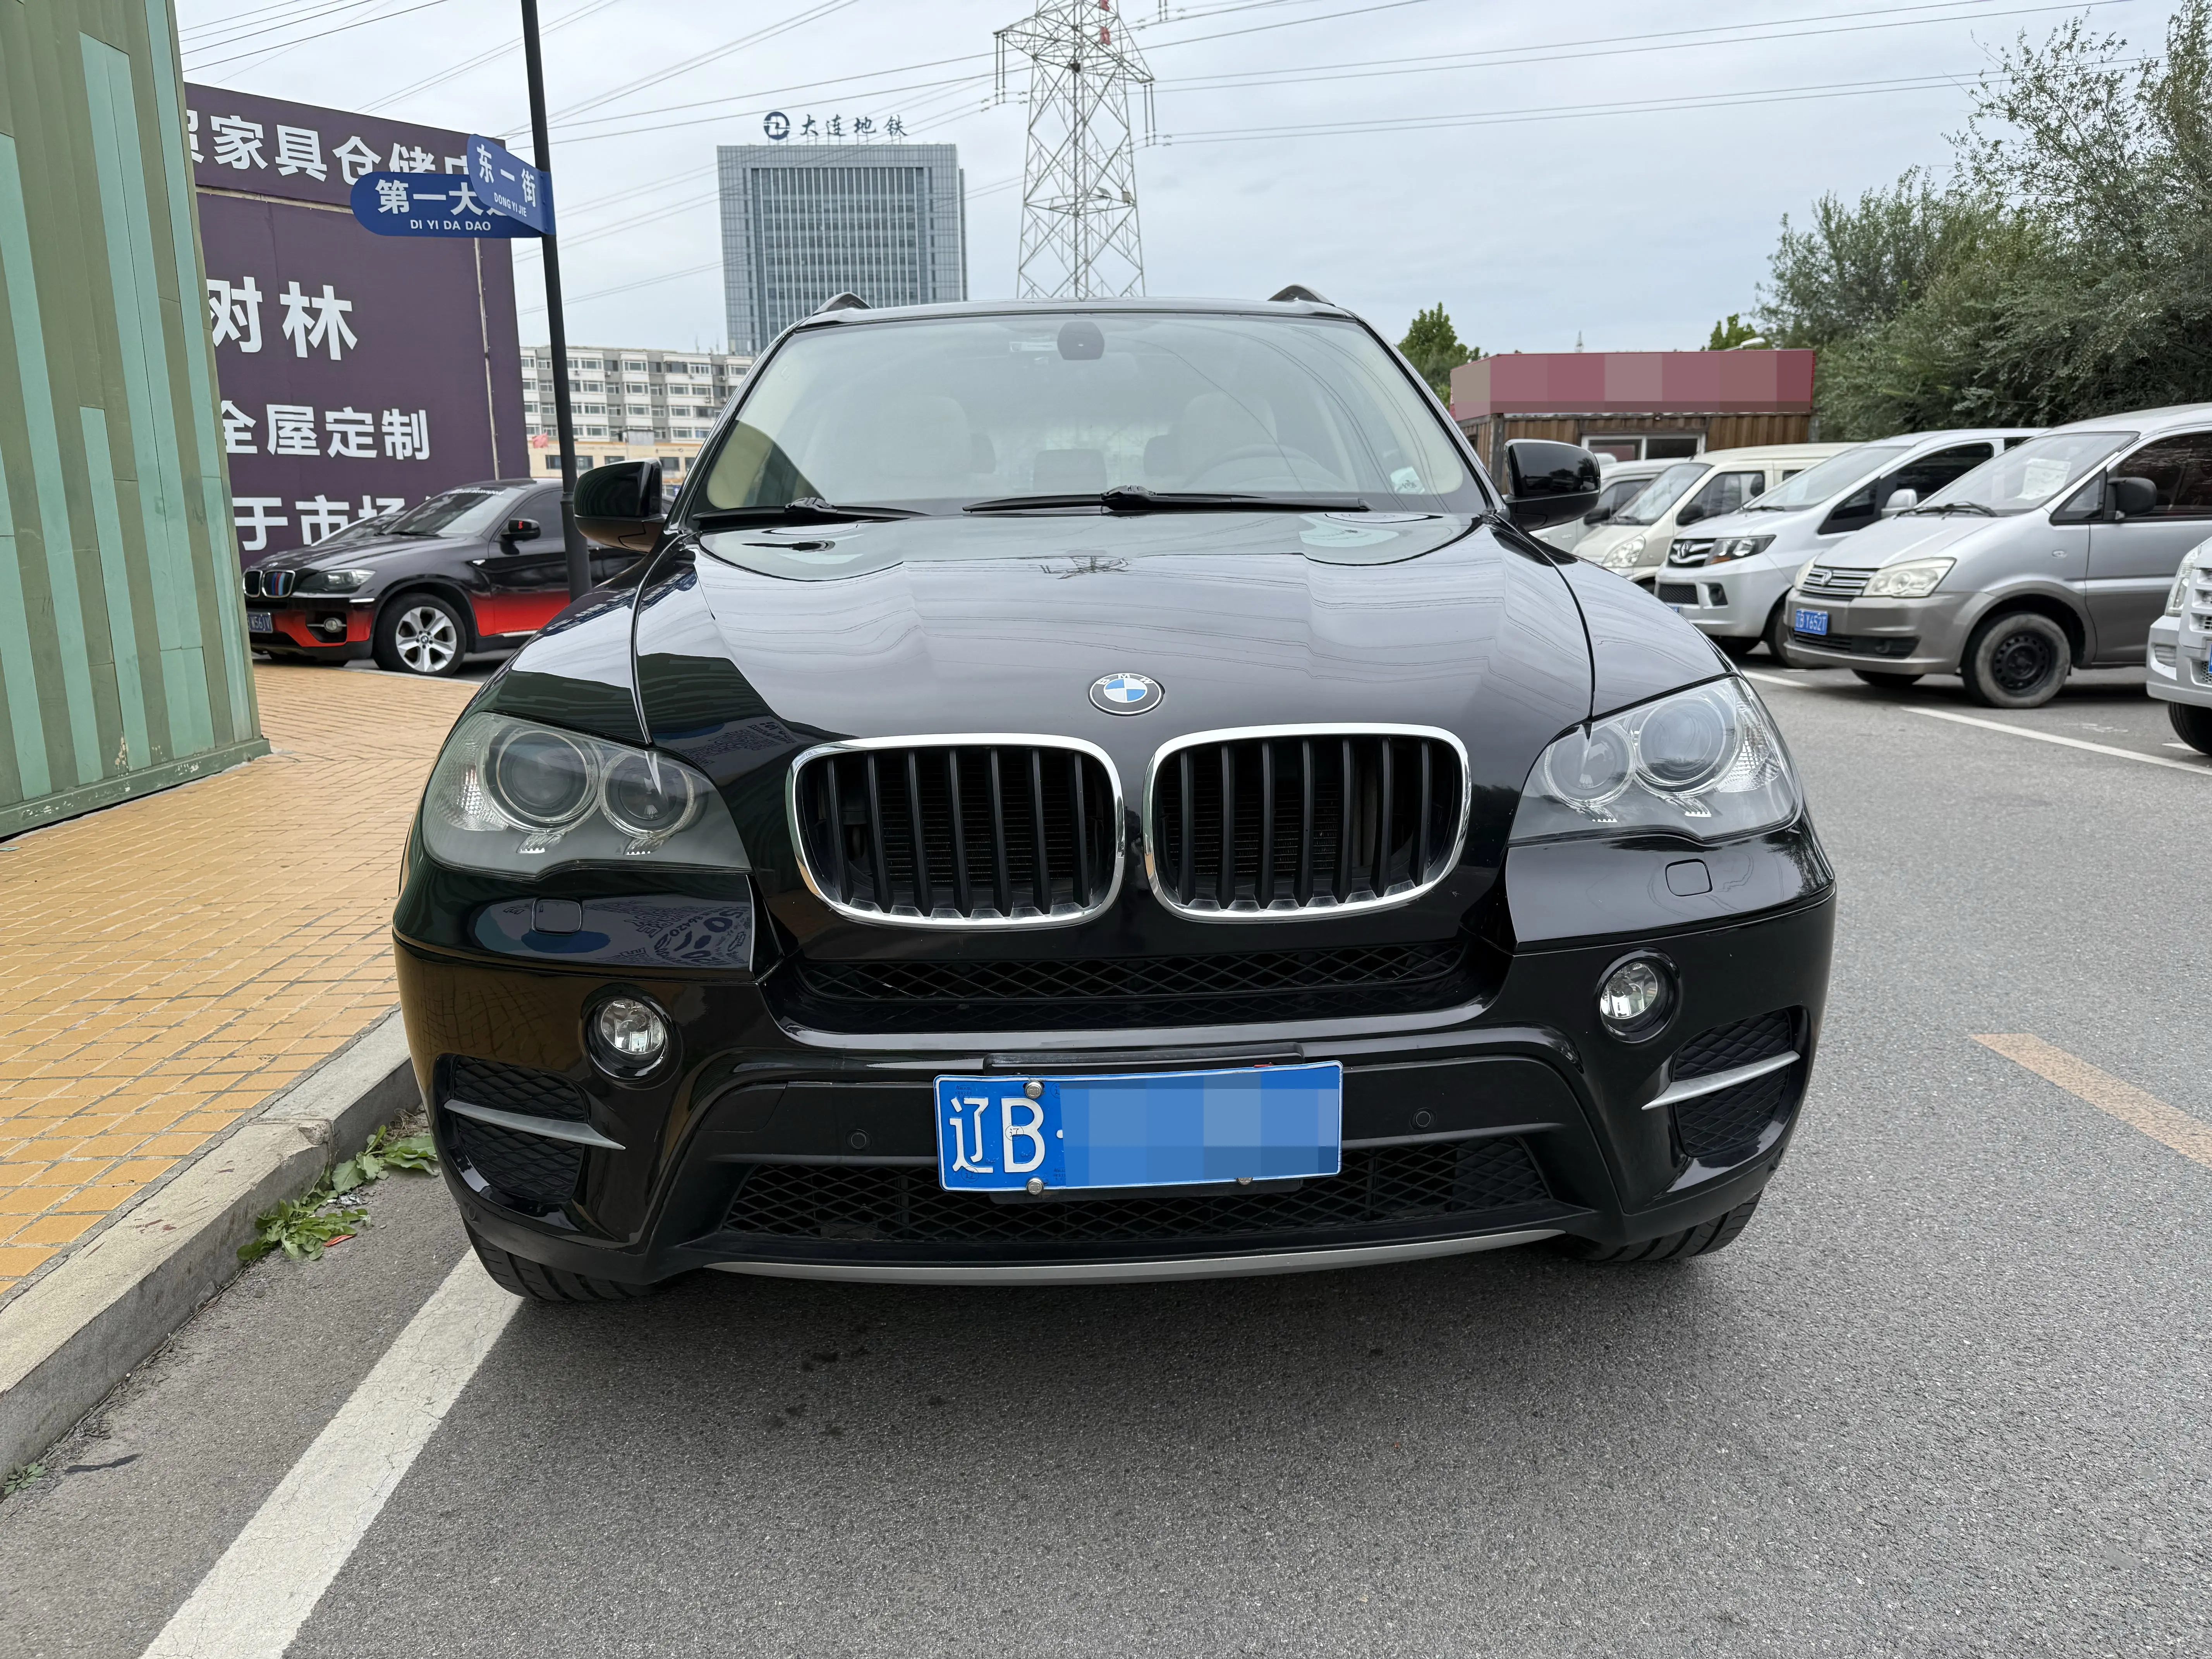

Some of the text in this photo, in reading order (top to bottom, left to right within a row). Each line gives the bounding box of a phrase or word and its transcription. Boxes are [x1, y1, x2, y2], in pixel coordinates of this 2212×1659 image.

[800, 114, 908, 136] 大连地铁
[477, 144, 536, 207] 东一街
[375, 179, 508, 216] 第一大
[494, 192, 527, 217] DONG YI JIE
[410, 220, 491, 231] DI YI DA DAO
[221, 400, 430, 460] 全屋定制
[1096, 674, 1154, 685] BMW
